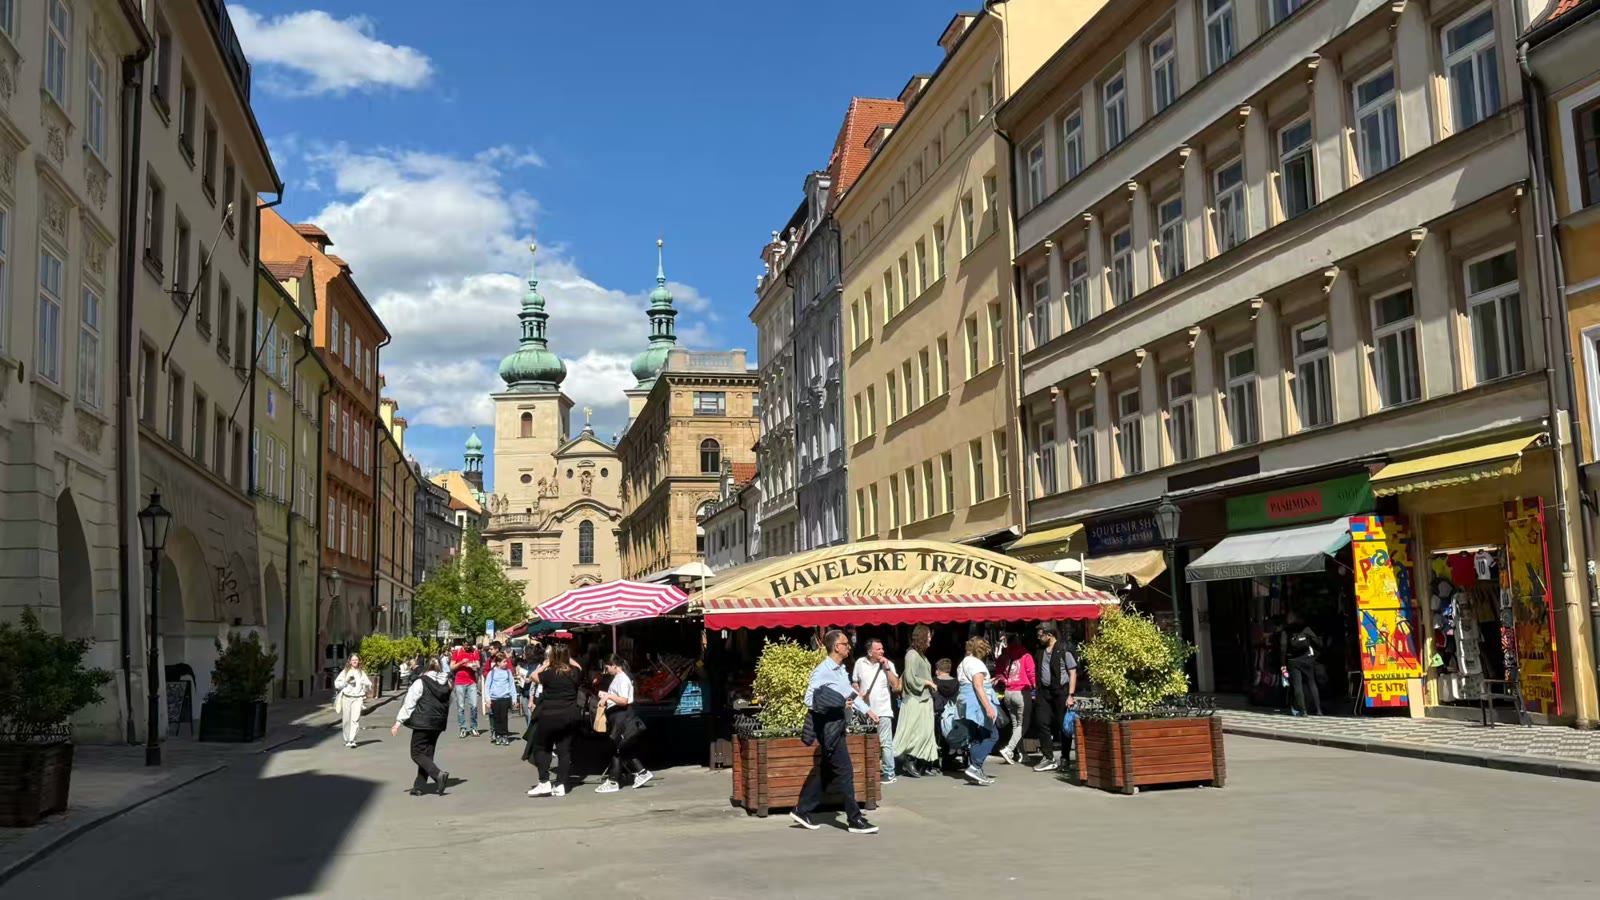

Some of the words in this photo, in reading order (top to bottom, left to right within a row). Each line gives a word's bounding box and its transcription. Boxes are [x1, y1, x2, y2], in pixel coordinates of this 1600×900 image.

[1092, 521, 1137, 539] SOUVENIR
[1213, 565, 1256, 578] PASHMINA
[1264, 562, 1290, 574] SHOP
[1370, 682, 1408, 692] CENTR
